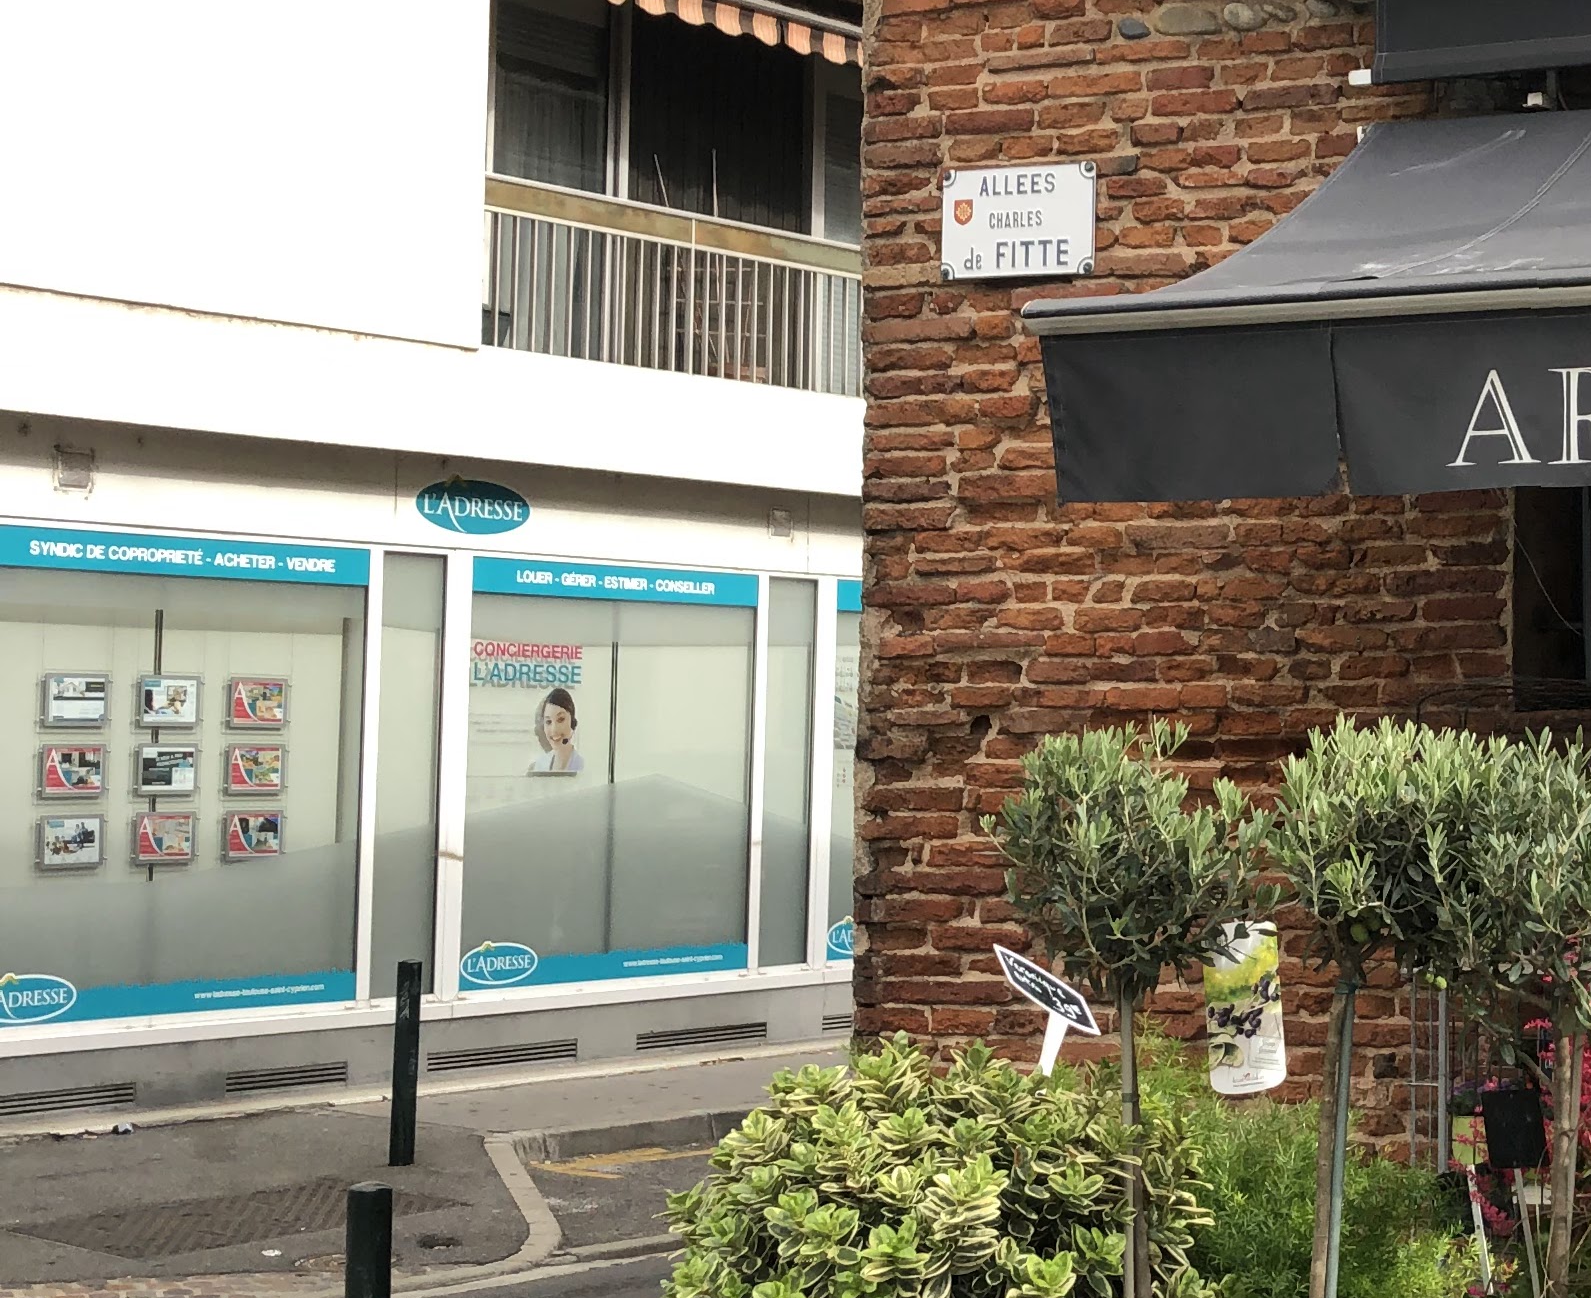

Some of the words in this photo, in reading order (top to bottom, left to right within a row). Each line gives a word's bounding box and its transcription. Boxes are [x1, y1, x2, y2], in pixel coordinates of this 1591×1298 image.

[980, 173, 1056, 197] ALLEES
[989, 210, 1042, 229] CHARLES
[963, 247, 982, 270] de
[996, 239, 1068, 269] FITTE
[424, 491, 523, 533] L'ADRESSE
[29, 540, 83, 558] SYNDIC
[86, 545, 105, 560] DE
[214, 553, 275, 570] ACHETER
[286, 557, 336, 573] VENDRE
[517, 570, 552, 585] LOUER
[562, 571, 596, 587] GÉRER
[604, 576, 647, 591] ESTIMER
[655, 580, 715, 595] CONSEILLER
[473, 642, 583, 660] CONCIERGERIE
[474, 662, 582, 684] L'ADRESSE
[467, 955, 531, 981] L'ADRESSE
